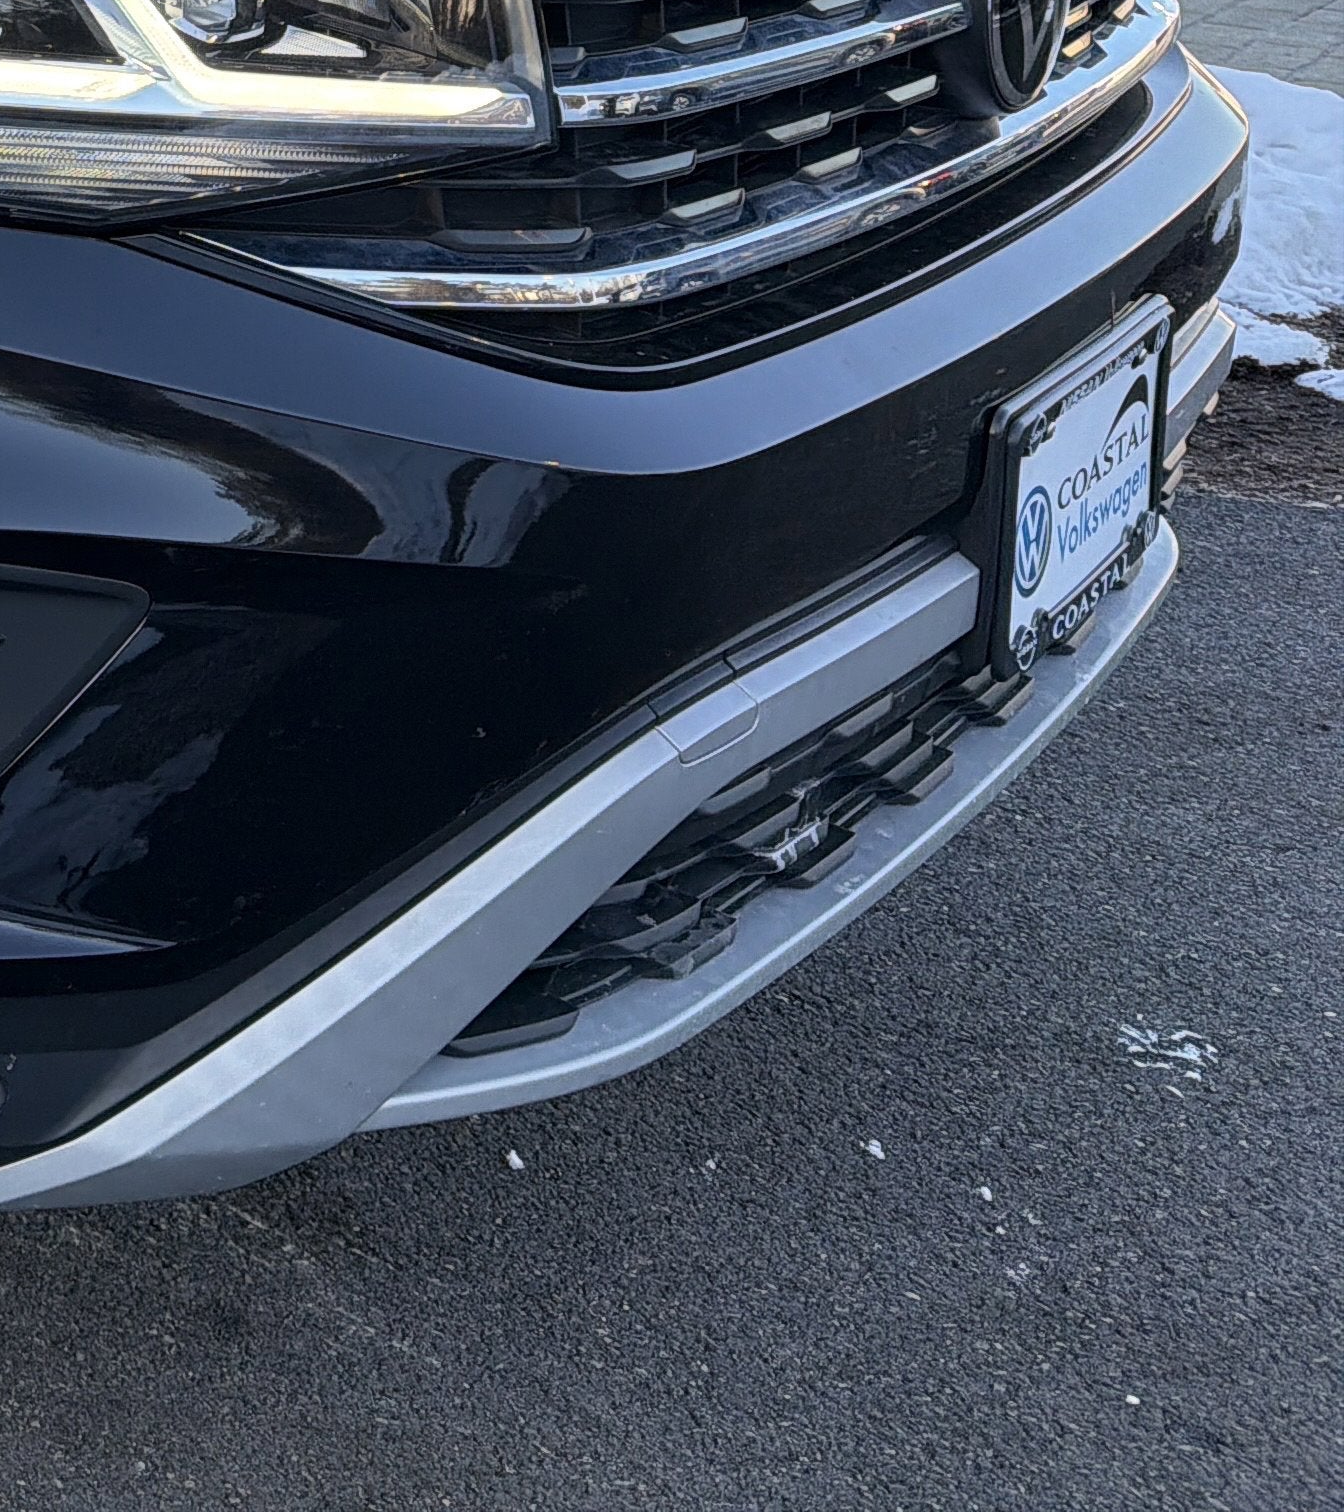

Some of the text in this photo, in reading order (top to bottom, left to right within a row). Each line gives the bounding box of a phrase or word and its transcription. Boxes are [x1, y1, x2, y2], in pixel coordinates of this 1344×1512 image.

[1057, 413, 1149, 509] COASTAL
[1057, 461, 1147, 563] Volkswagen
[1052, 552, 1131, 639] COASTAL
